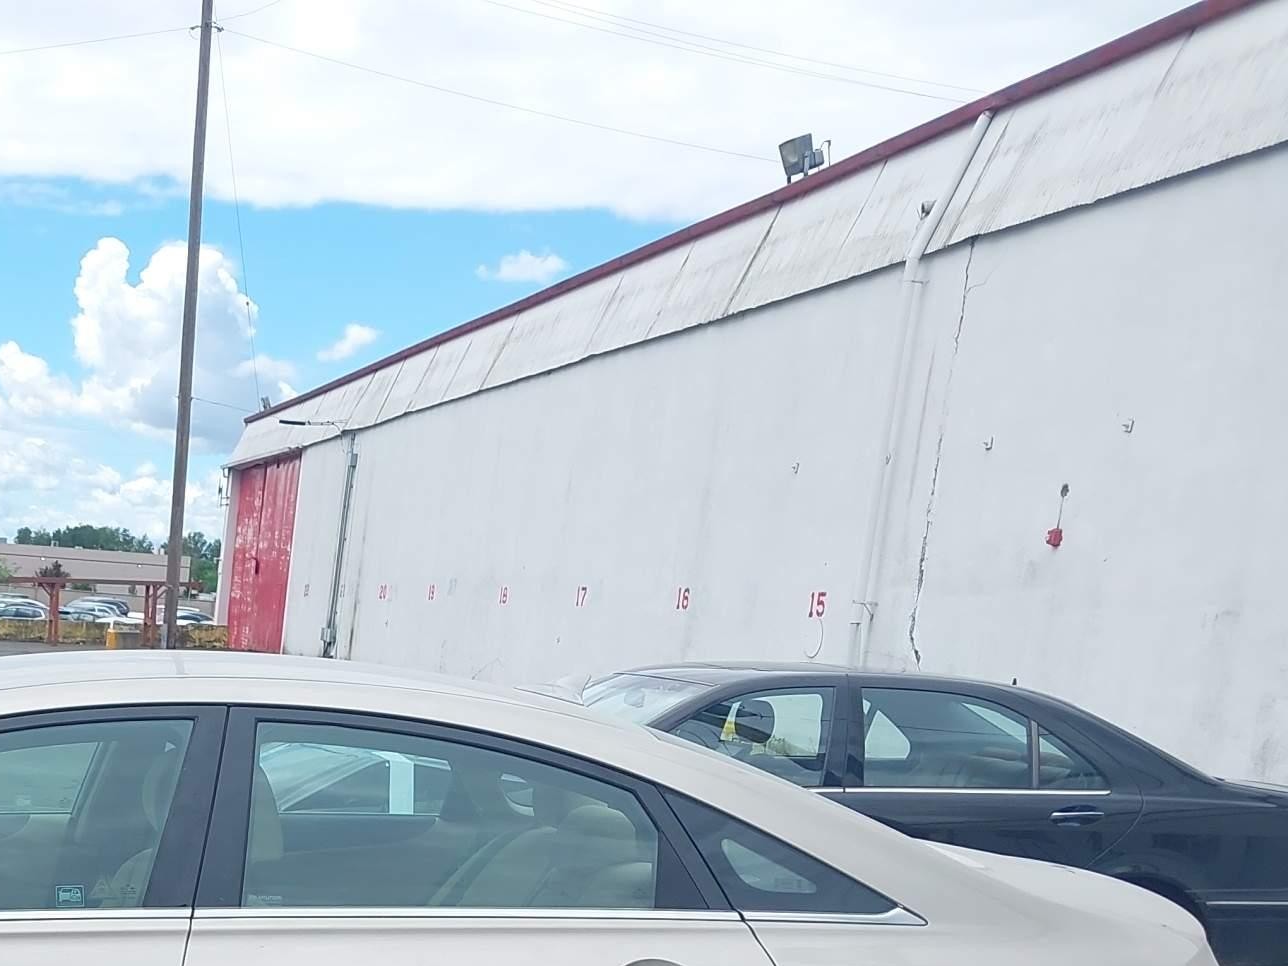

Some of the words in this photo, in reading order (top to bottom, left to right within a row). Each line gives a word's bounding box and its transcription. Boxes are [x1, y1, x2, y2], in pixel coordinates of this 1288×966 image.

[498, 586, 508, 605] 18
[575, 586, 588, 607] 17
[675, 587, 690, 610] 16
[808, 591, 827, 618] 15
